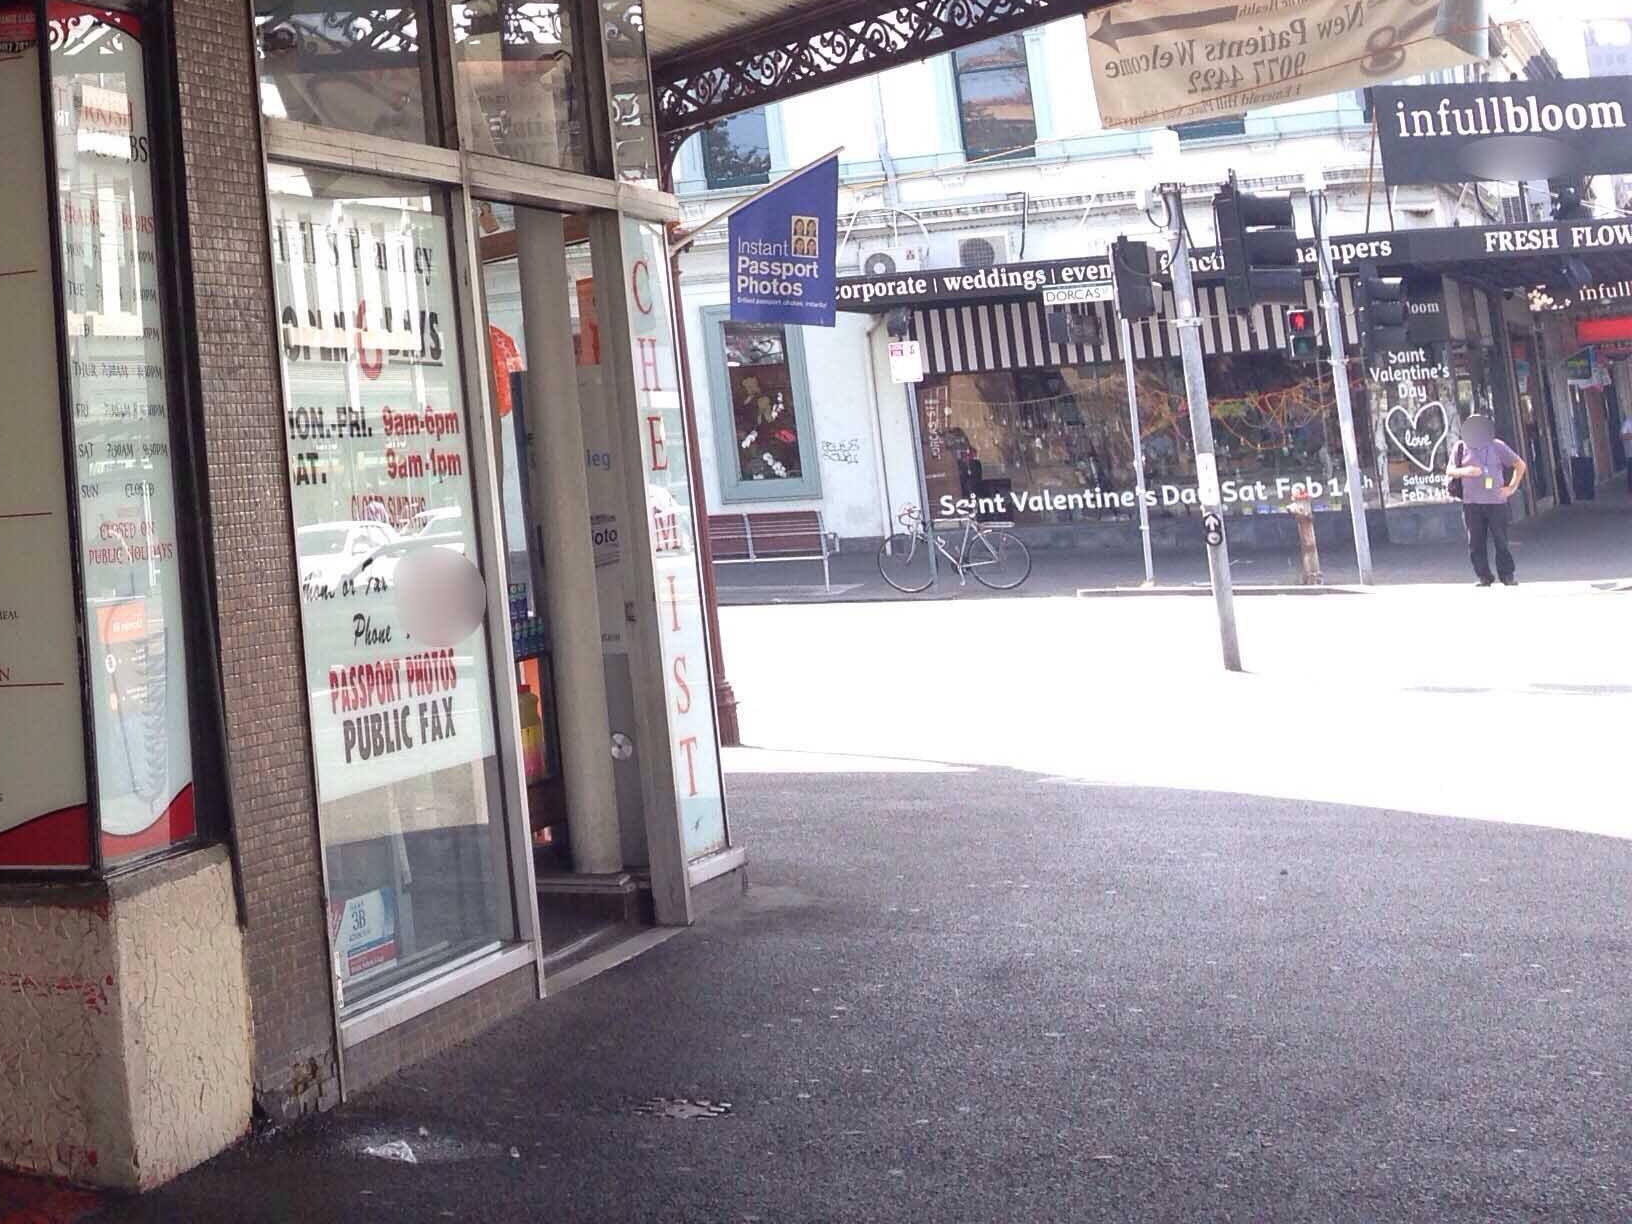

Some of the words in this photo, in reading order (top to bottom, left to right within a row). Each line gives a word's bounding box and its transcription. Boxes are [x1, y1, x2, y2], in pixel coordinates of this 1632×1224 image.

[1395, 94, 1626, 139] infullbloom
[737, 236, 790, 257] Instant
[736, 256, 819, 278] Passport
[943, 266, 1046, 293] weddings
[1061, 262, 1113, 282] even
[1484, 227, 1560, 253] FRESH
[736, 276, 804, 297] Photos
[1045, 288, 1101, 303] DORCAS
[1388, 347, 1426, 364] Saint
[1369, 364, 1450, 383] Valentine's
[1398, 384, 1427, 403] Day
[287, 406, 373, 440] ON.-FRI.
[381, 405, 460, 441] 9am-6pm
[1405, 429, 1432, 447] love
[78, 442, 95, 460] SAT
[292, 452, 327, 487] AT.
[386, 447, 463, 484] 9am-1pm
[81, 483, 100, 498] SUN
[1402, 474, 1450, 490] Saturday
[1010, 485, 1158, 513] Valentine's
[1161, 484, 1204, 506] Da
[1221, 480, 1267, 502] Sat
[1276, 476, 1323, 500] Feb
[1401, 488, 1424, 502] Feb
[632, 259, 697, 797] CHEMIST
[88, 545, 124, 566] PUBLIC
[352, 612, 392, 647] Phone
[328, 659, 403, 715] PASSPORT
[405, 647, 458, 698] PHOTOS
[342, 704, 414, 764] PUBLIC
[418, 696, 457, 745] FAX
